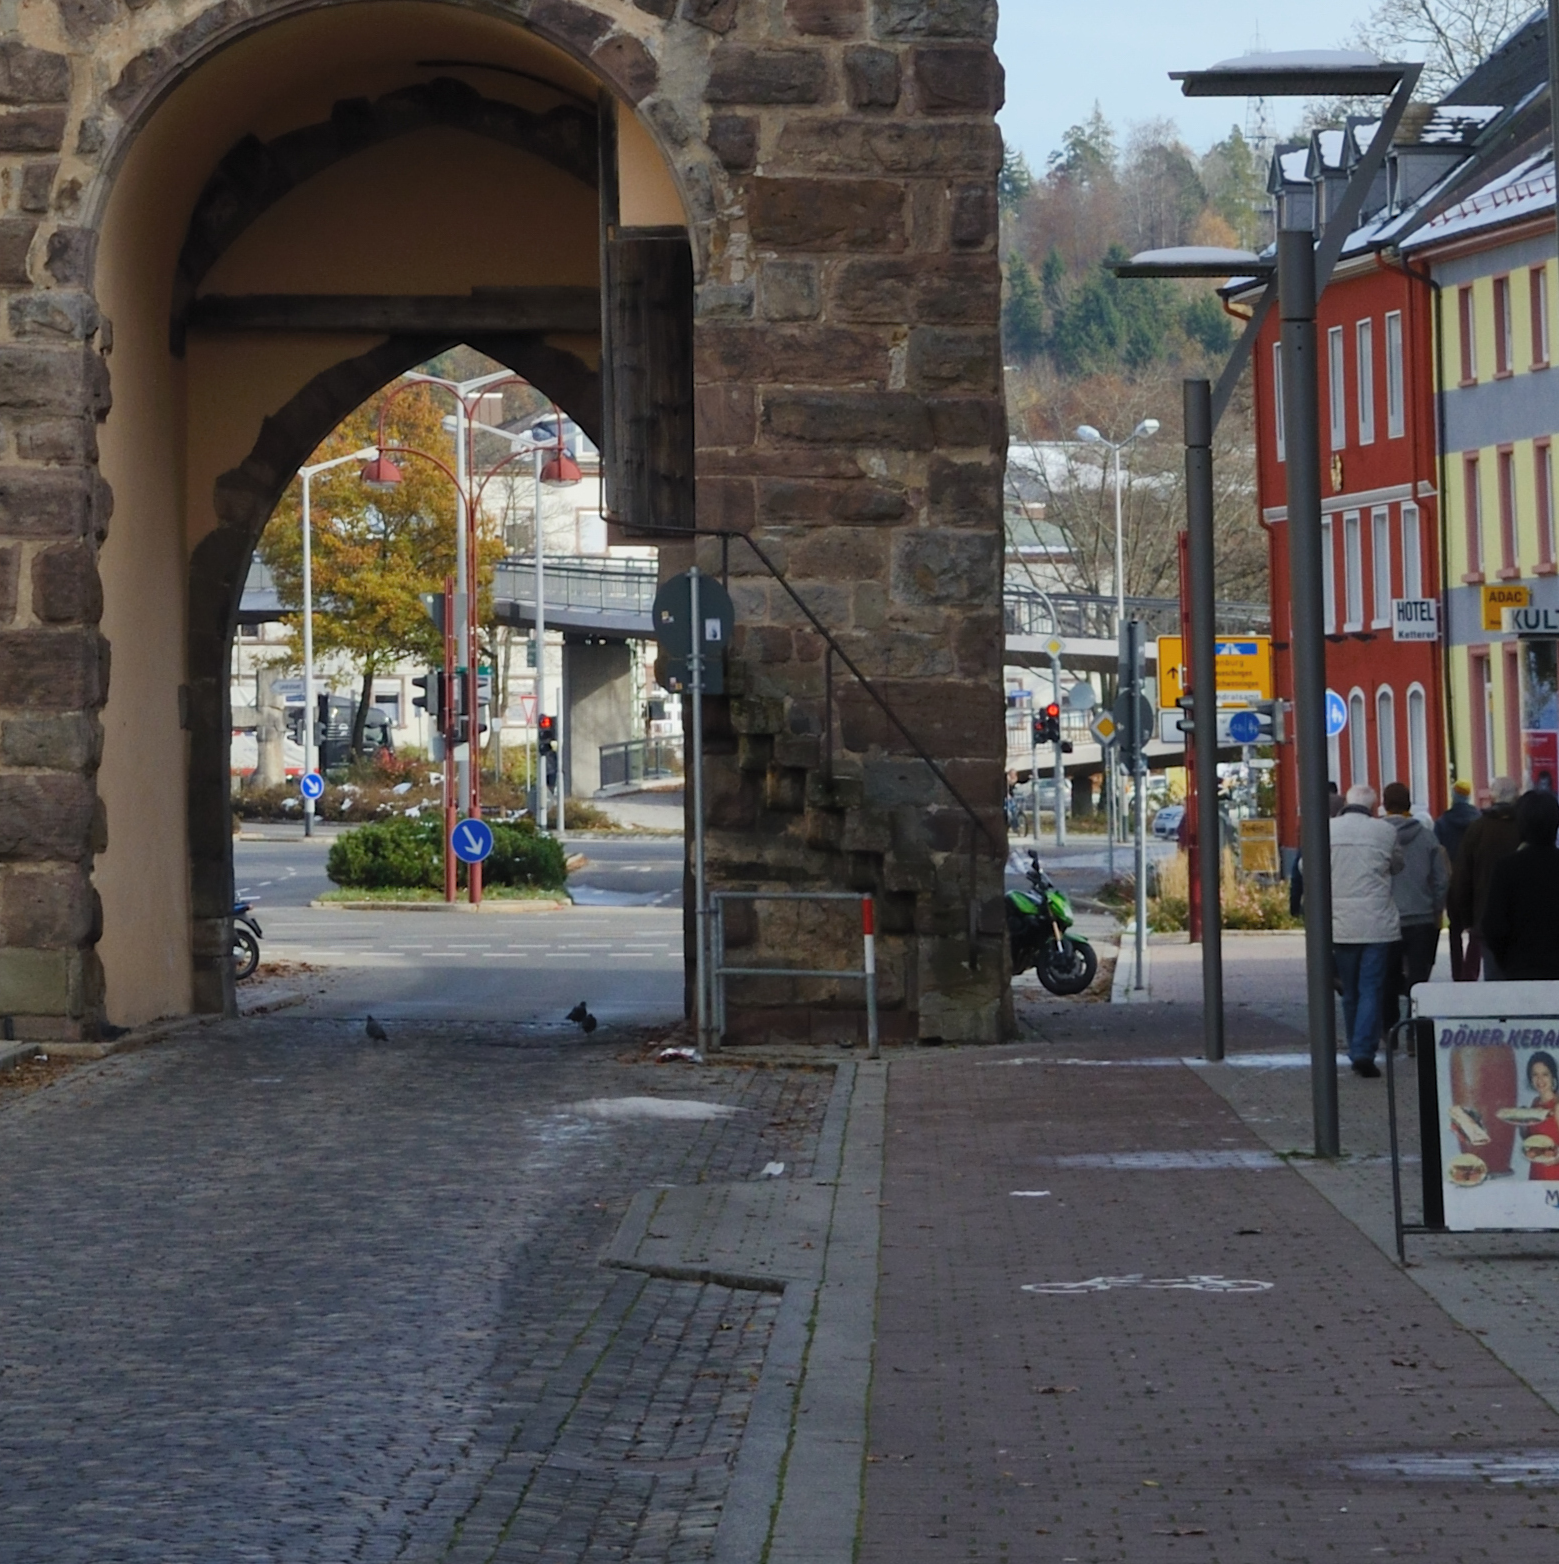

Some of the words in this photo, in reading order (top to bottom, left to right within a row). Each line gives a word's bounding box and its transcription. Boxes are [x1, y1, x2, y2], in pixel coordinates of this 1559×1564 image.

[1489, 591, 1523, 603] ADAC
[1397, 601, 1435, 622] HOTEL
[1398, 630, 1436, 639] Ketterer
[1439, 1023, 1505, 1049] DÖNER
[1506, 1028, 1559, 1050] KEBA
